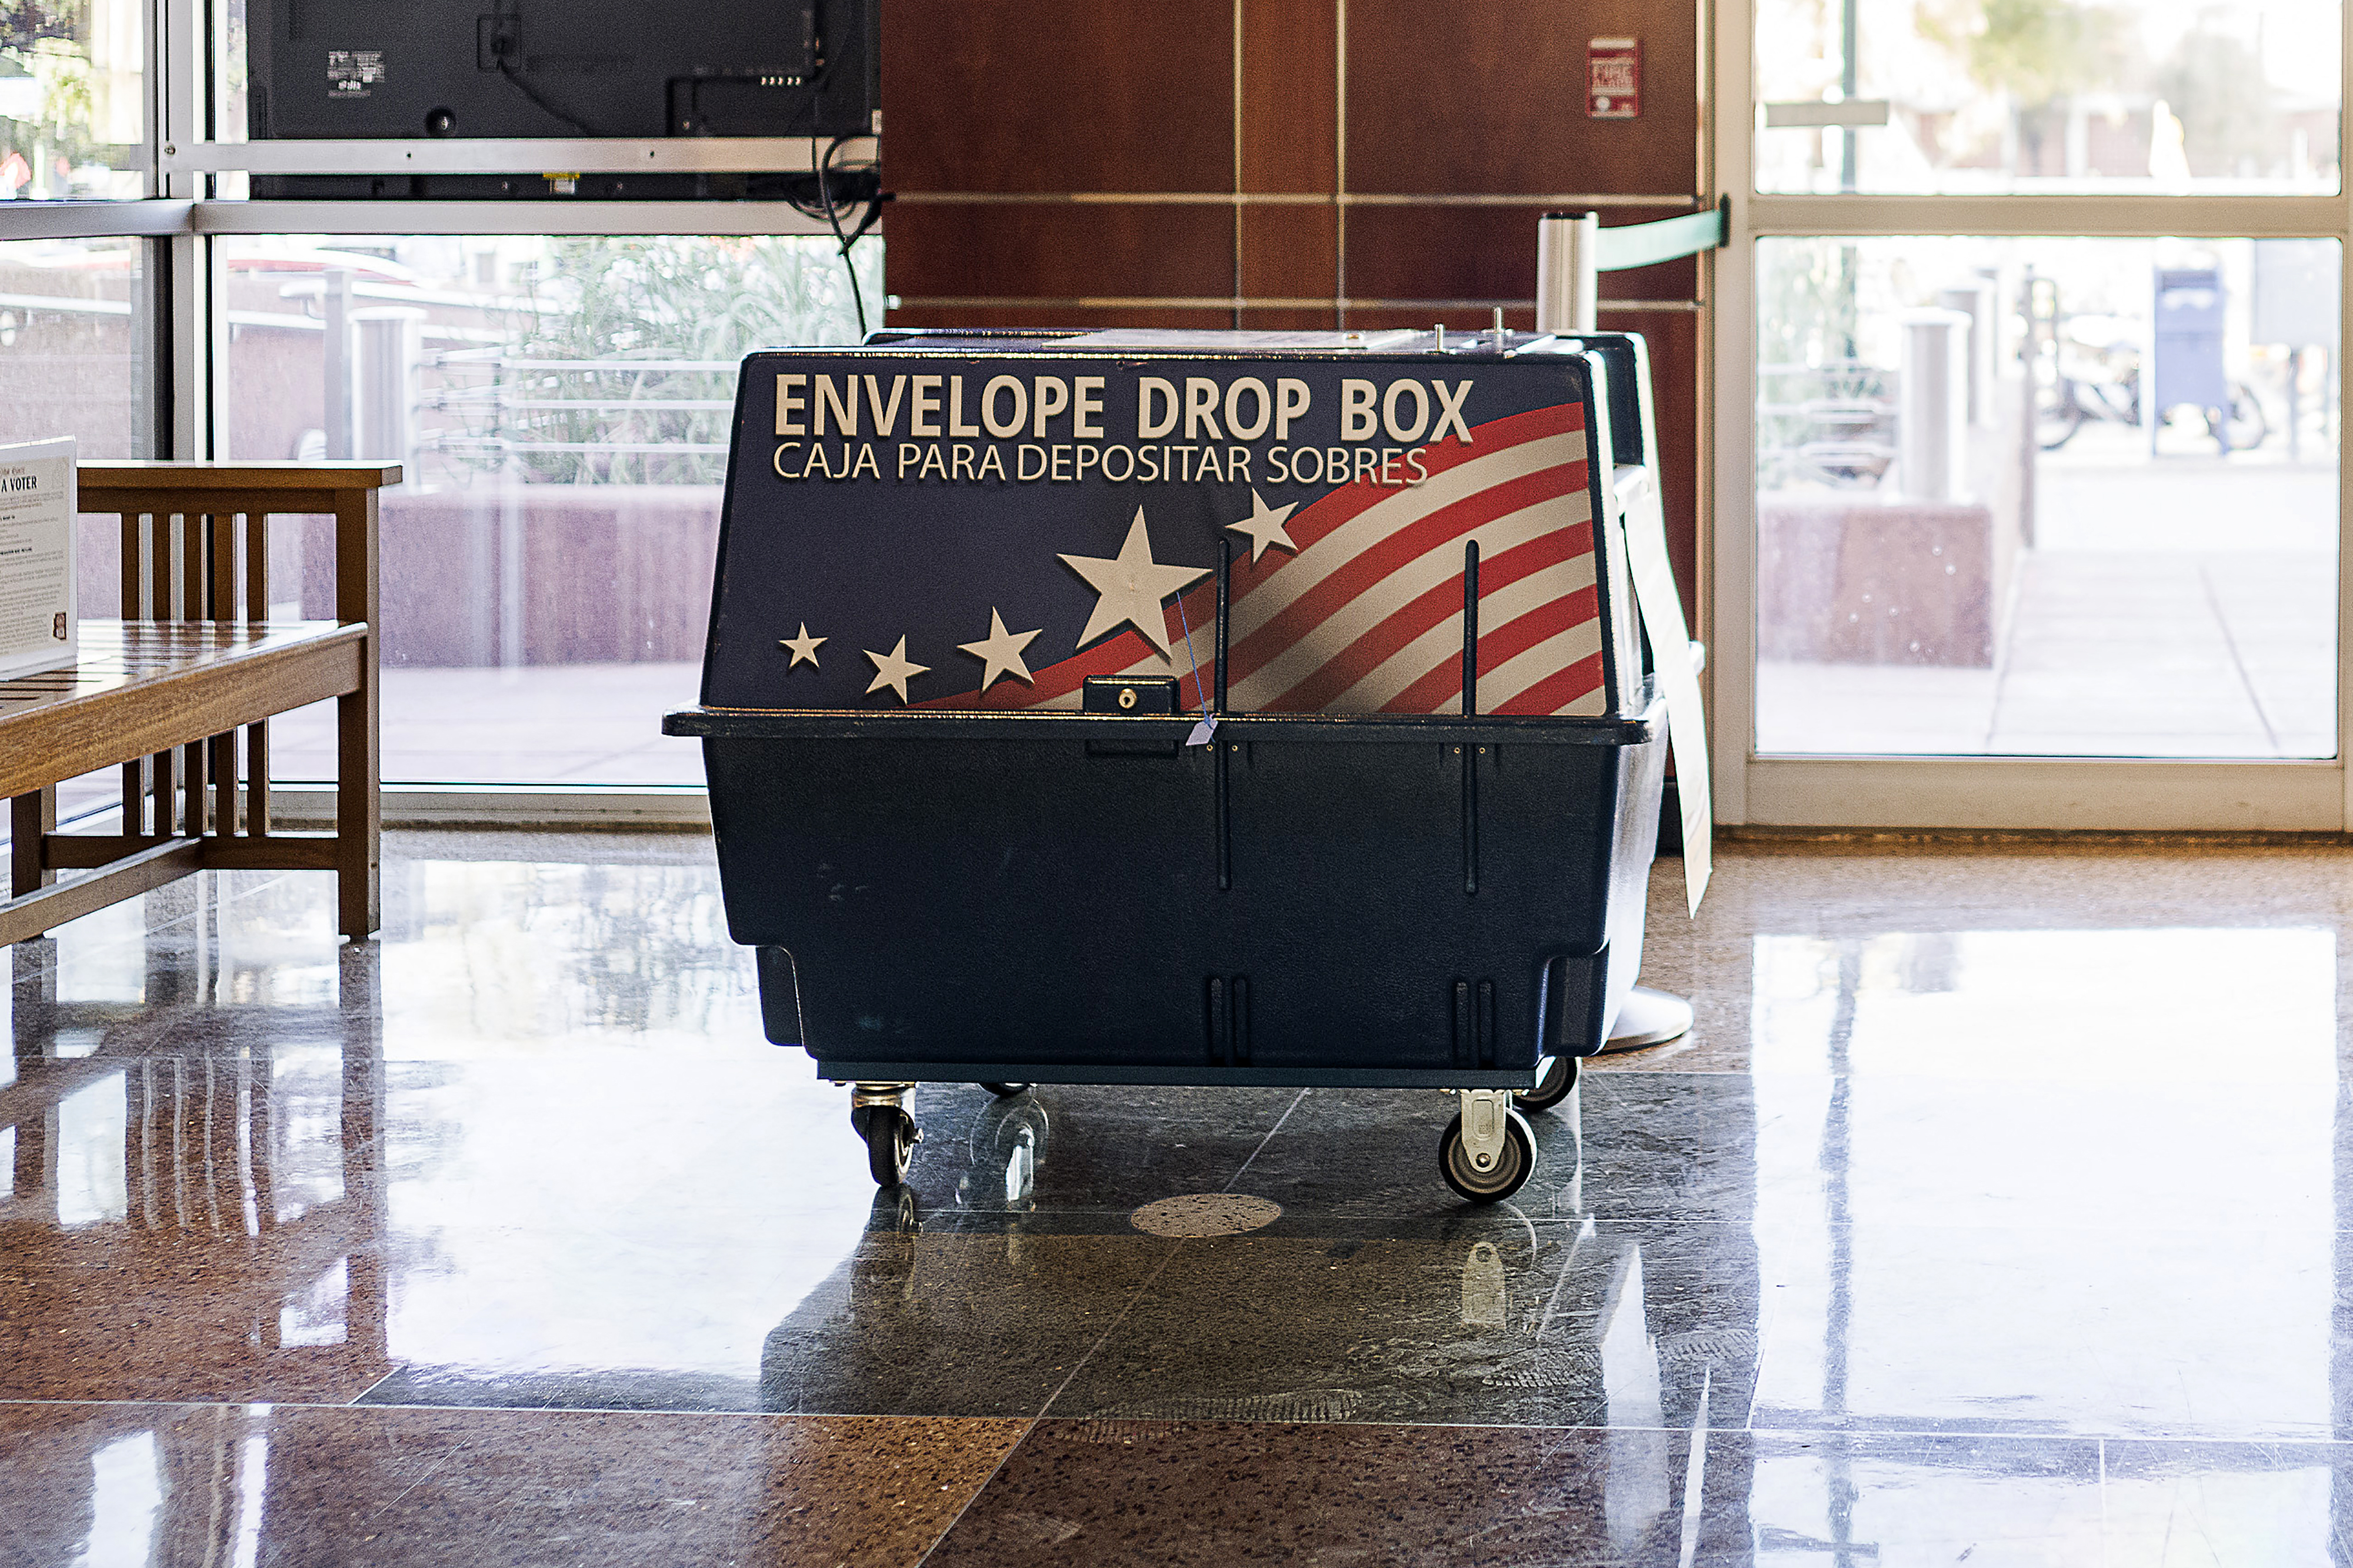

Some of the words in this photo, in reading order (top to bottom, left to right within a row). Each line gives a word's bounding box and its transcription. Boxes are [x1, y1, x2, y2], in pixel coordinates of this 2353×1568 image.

[775, 374, 1105, 439] ENVELOPE
[1138, 377, 1311, 441] DROP
[1341, 379, 1474, 443] BOX
[1, 479, 7, 493] A
[10, 475, 37, 492] VOTER
[774, 442, 881, 480] CAJA
[898, 443, 1006, 481] PARA
[1017, 444, 1252, 483] DEPOSITAR
[1267, 446, 1428, 485] SOBRES
